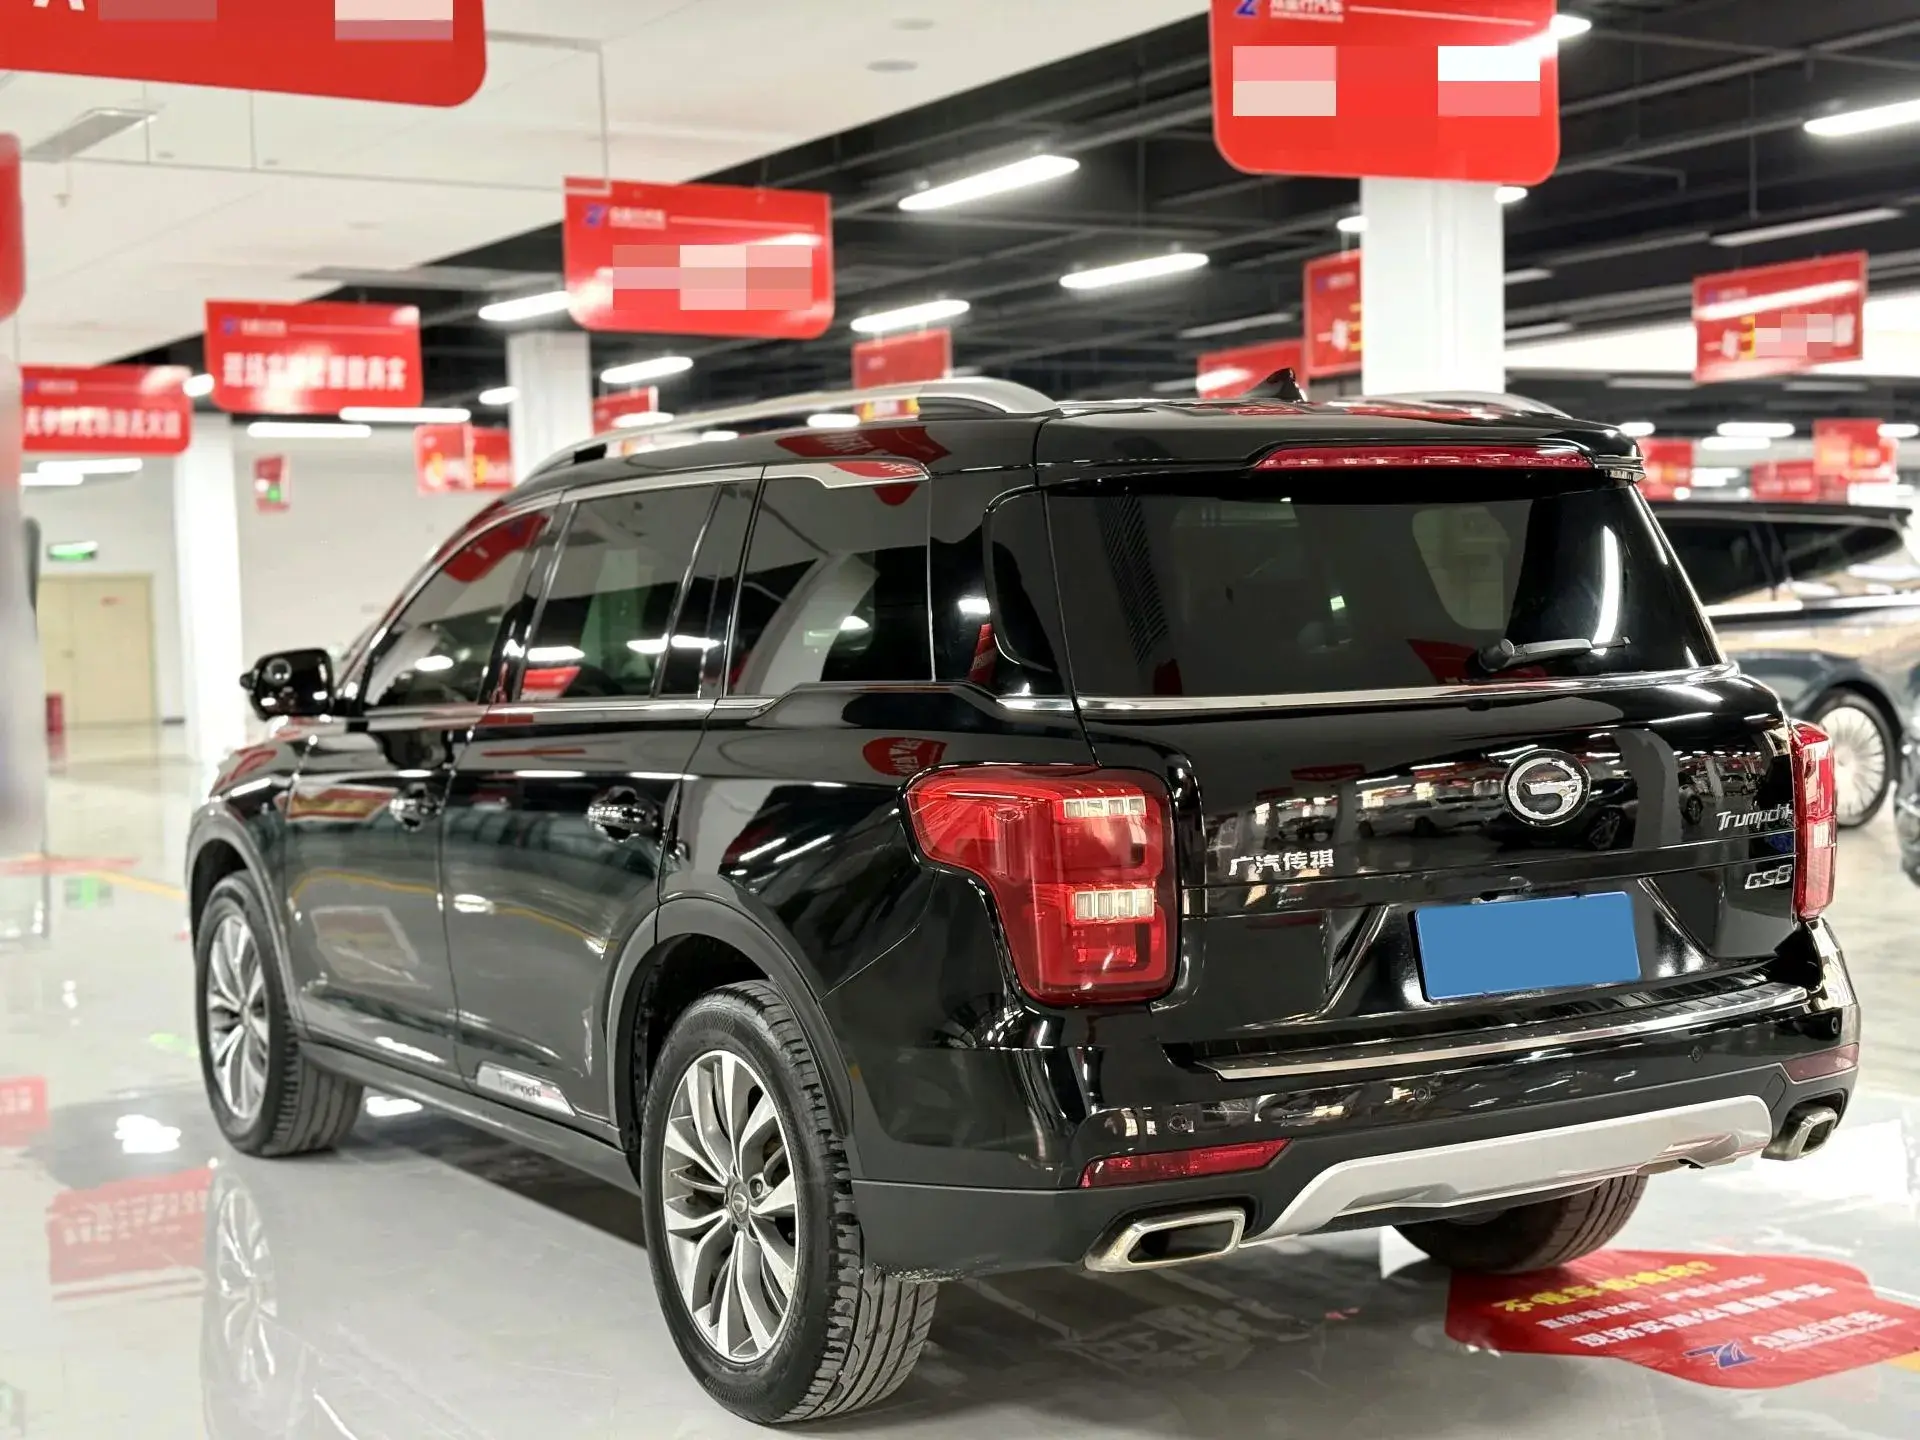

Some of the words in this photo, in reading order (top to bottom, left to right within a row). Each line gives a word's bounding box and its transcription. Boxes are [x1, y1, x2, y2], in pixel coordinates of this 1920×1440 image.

[1228, 848, 1335, 876] 广汽传祺
[1744, 863, 1793, 889] GS8
